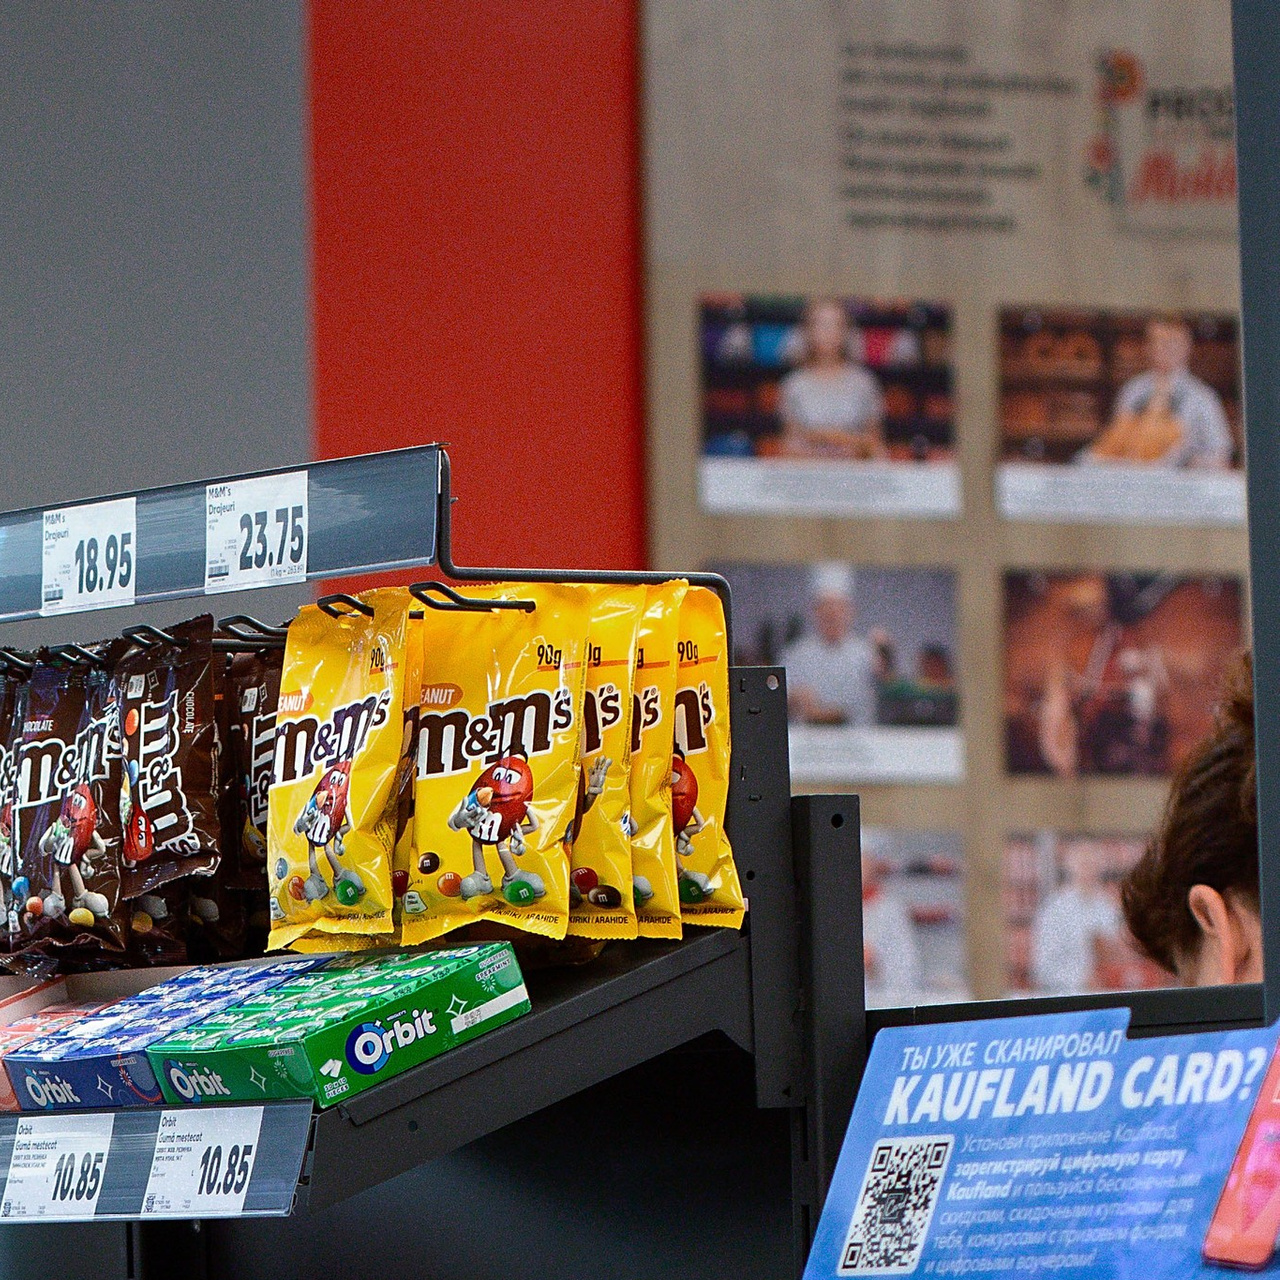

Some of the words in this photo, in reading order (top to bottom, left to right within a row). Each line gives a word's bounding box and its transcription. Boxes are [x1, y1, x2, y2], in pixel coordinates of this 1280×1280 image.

[208, 501, 236, 516] Drajeuri
[44, 528, 70, 542] Drajeuri
[239, 505, 304, 571] 23.75
[74, 532, 132, 594] 18.95
[537, 645, 562, 670] 90g
[677, 640, 699, 664] 90g
[23, 720, 54, 732] HOCOLATE
[184, 691, 196, 735] CHOCOLATE
[270, 691, 392, 789] m&m's
[418, 691, 573, 780] m&m's
[595, 916, 629, 925] ARAHIDE
[475, 958, 512, 982] SPEARMINT
[353, 1008, 438, 1067] Orbit
[901, 1045, 931, 1072] ТЫ
[932, 1040, 977, 1069] УЖЕ
[983, 1029, 1123, 1065] СКАНИРОВАЛ
[25, 1076, 81, 1108] Orbit
[169, 1068, 232, 1102] Orbit
[326, 1083, 350, 1100] PIECES
[882, 1059, 1116, 1127] KAUFLAND
[1120, 1046, 1268, 1110] CARD?
[18, 1125, 33, 1135] Orbit
[161, 1116, 177, 1128] Orbit
[31, 1140, 58, 1150] mestecat
[175, 1131, 203, 1143] mestecat
[51, 1152, 105, 1202] 10.85
[197, 1144, 254, 1196] 10.85
[954, 1152, 1061, 1180] зарегистрируй
[1061, 1150, 1141, 1176] цифровую
[1141, 1149, 1188, 1169] карту
[946, 1178, 1014, 1201] Kaufland
[1024, 1178, 1093, 1199] пользуйся
